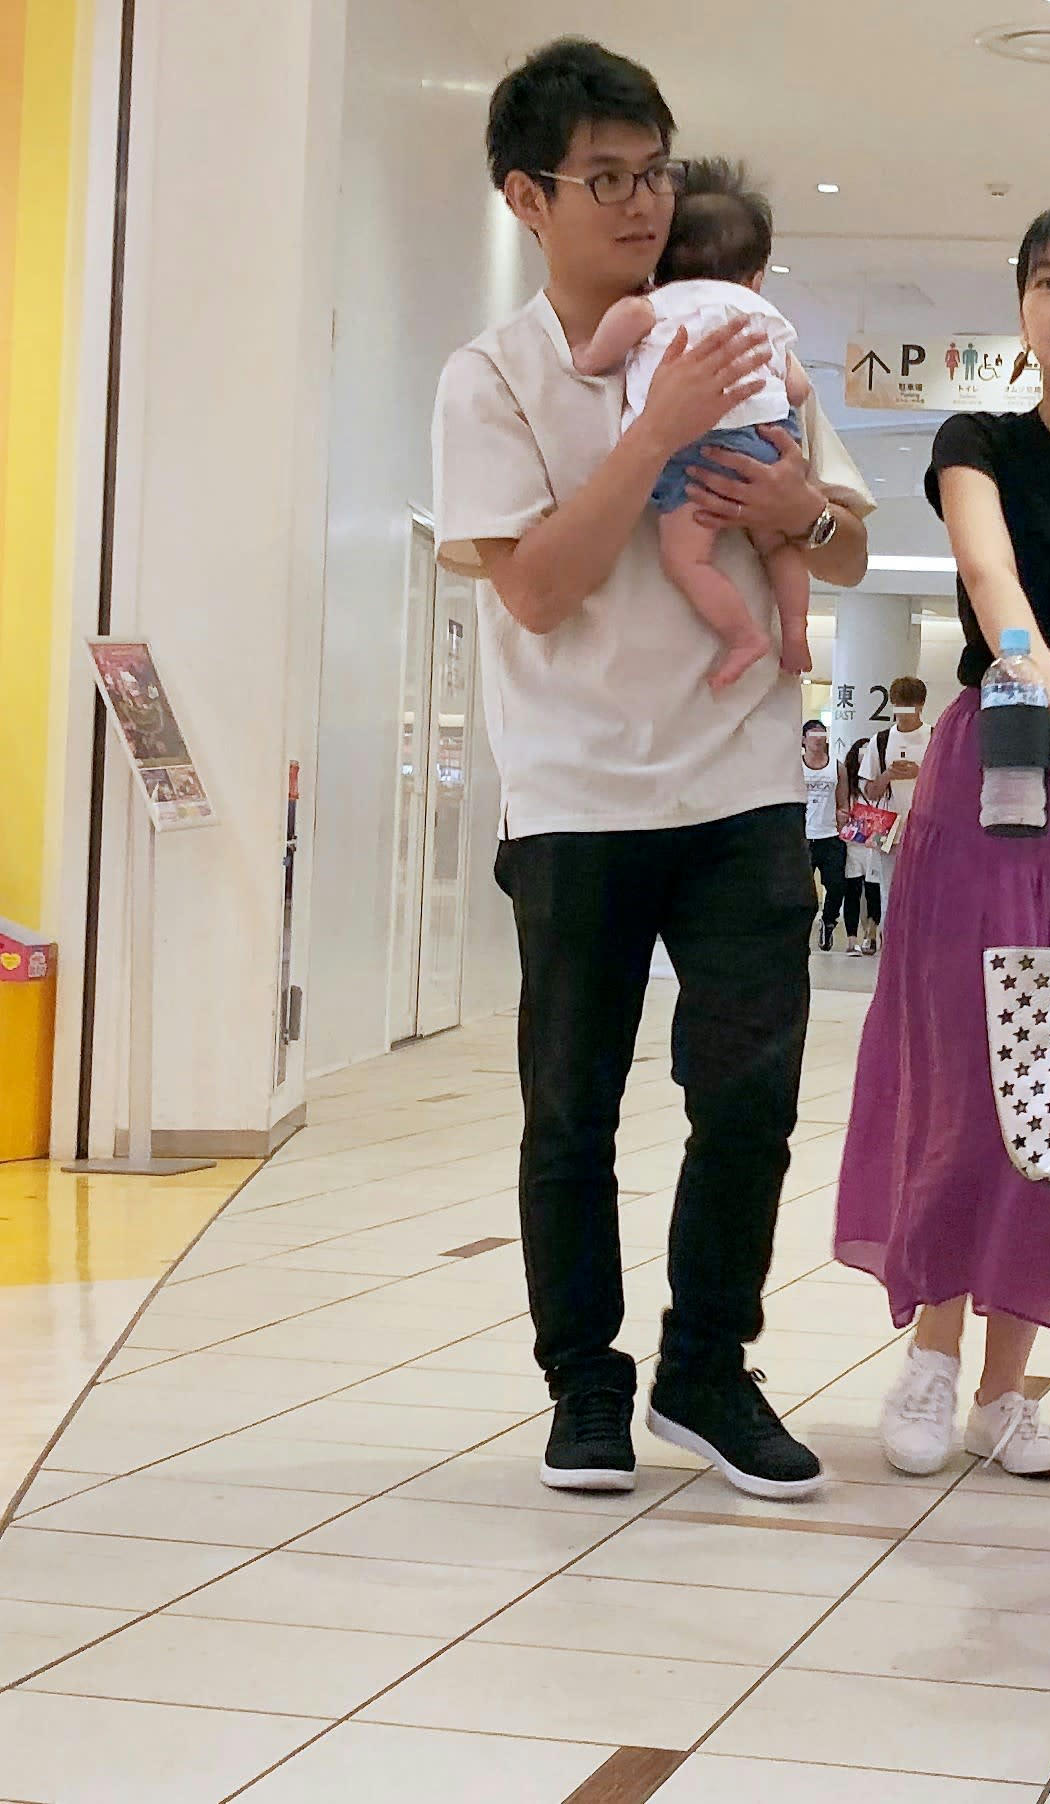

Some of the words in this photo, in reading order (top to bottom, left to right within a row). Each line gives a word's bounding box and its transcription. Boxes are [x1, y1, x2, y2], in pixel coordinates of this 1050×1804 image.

[901, 344, 926, 376] P
[958, 384, 978, 393] トイレ
[837, 683, 855, 708] 東
